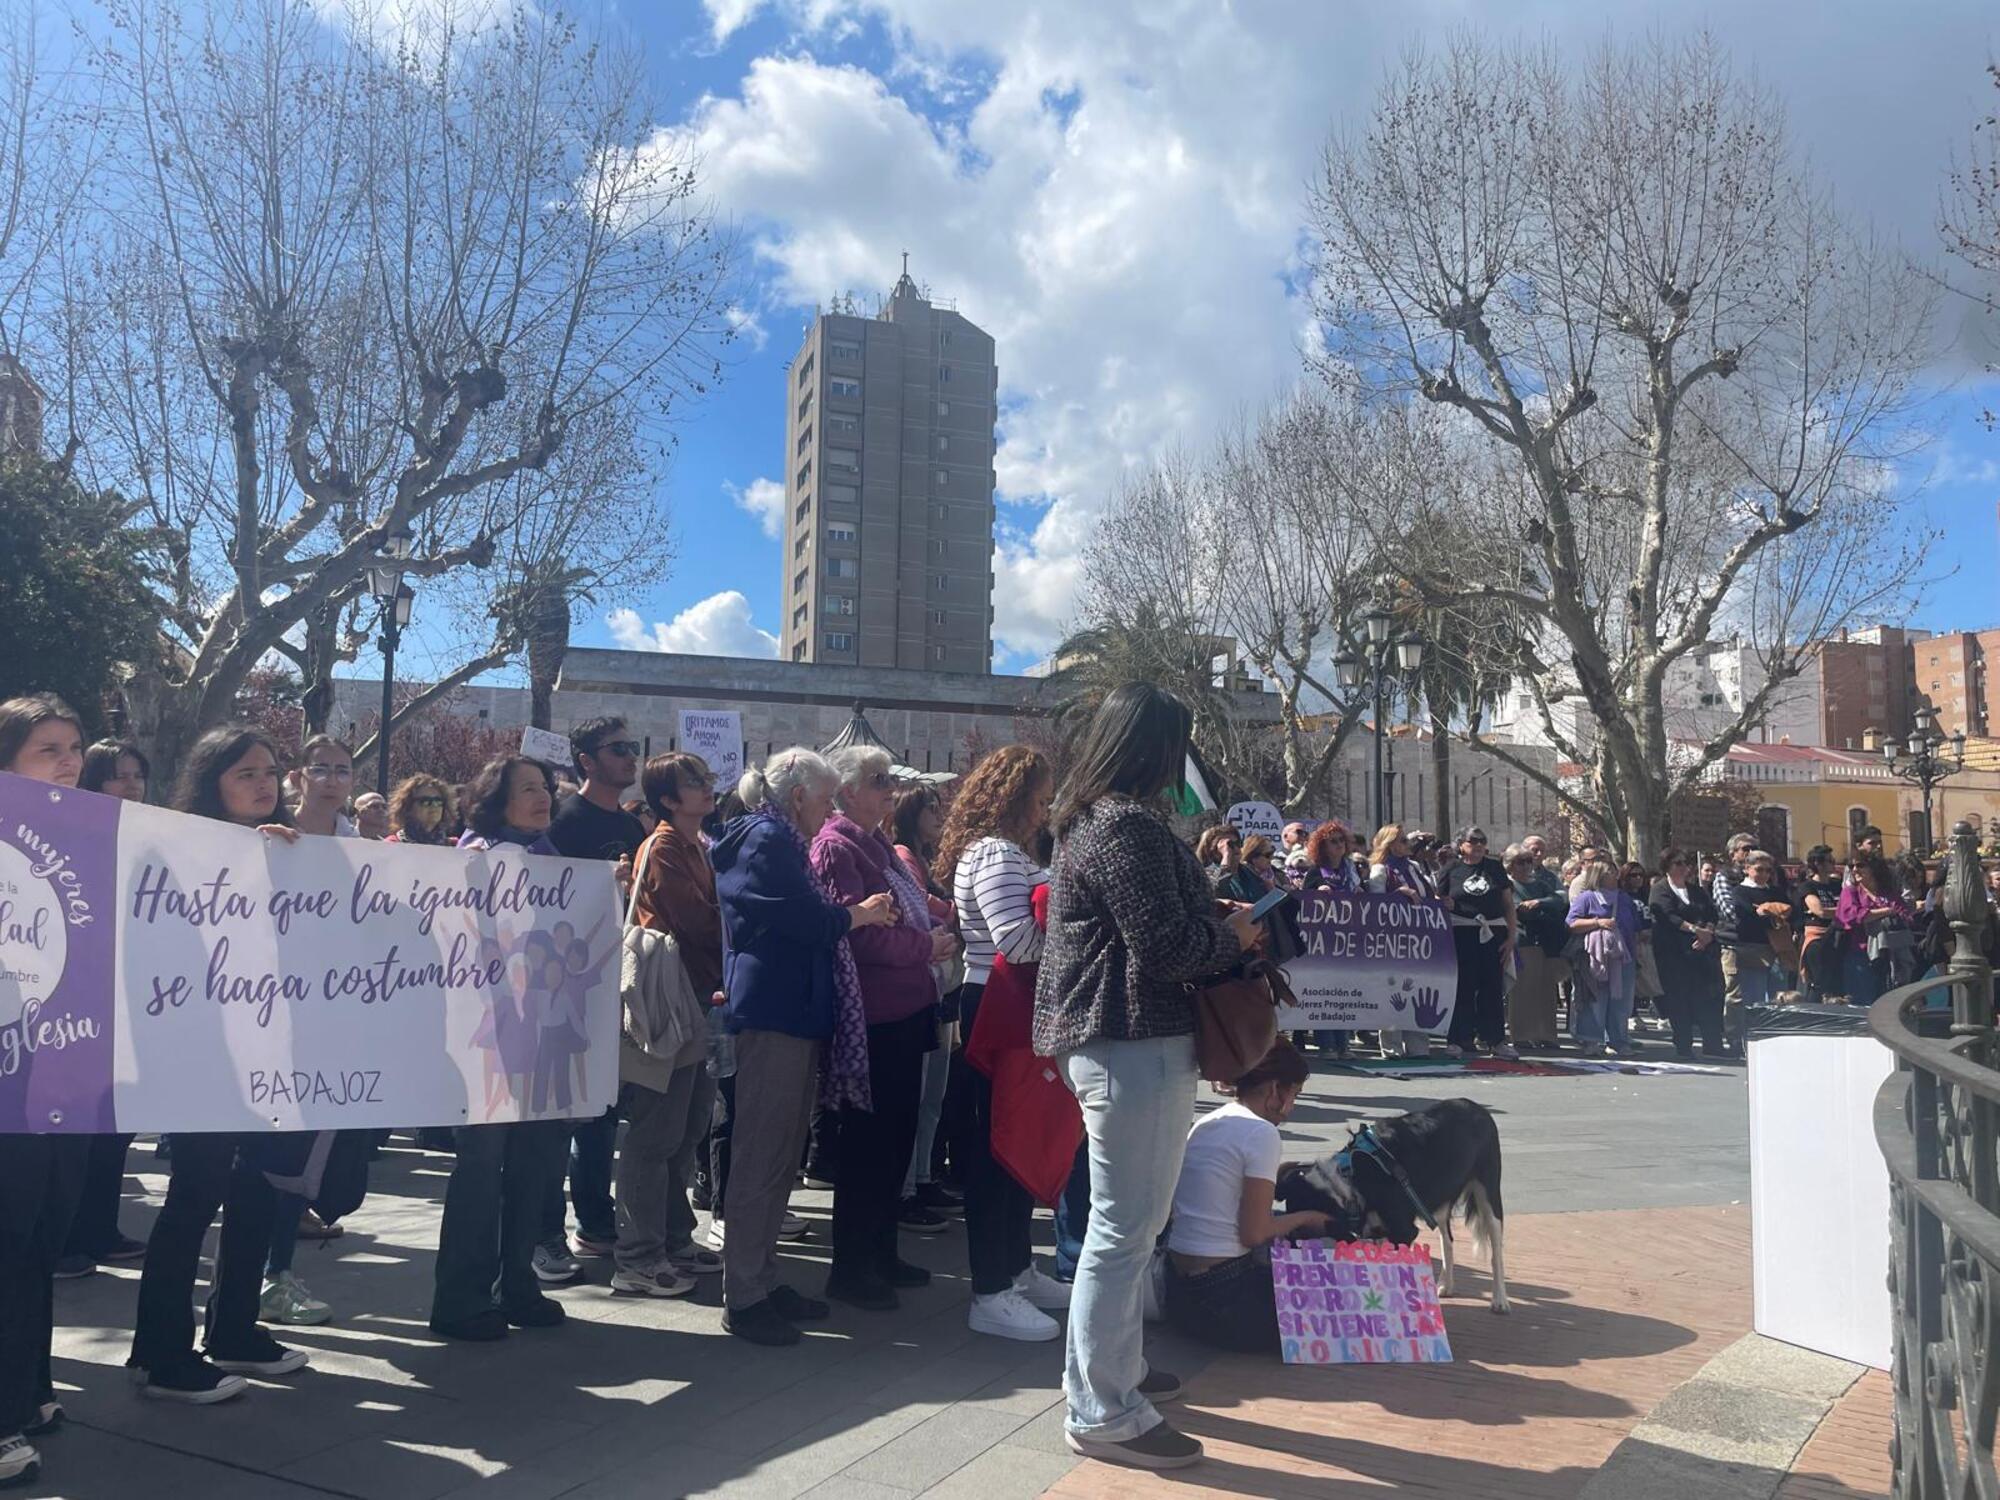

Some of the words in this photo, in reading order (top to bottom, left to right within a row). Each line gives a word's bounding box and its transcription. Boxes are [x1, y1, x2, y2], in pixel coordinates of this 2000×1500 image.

[723, 752, 737, 763] NO
[1245, 821, 1279, 830] PARA
[17, 823, 94, 929] mujeres
[133, 864, 256, 926] Hasta
[268, 886, 337, 935] que
[350, 864, 399, 924] la
[407, 861, 577, 935] igualdad
[1297, 900, 1352, 925] LDAD
[1360, 902, 1371, 926] Y
[1378, 902, 1448, 930] CONTRA
[1333, 931, 1357, 957] DE
[1364, 929, 1433, 960] GÉNERO
[146, 971, 193, 1017] se
[205, 936, 308, 1028] haga
[323, 934, 508, 1005] costumbre
[1302, 987, 1350, 997] Asociación
[1351, 987, 1363, 997] de
[1308, 1012, 1319, 1021] de
[1321, 1012, 1356, 1022] Badajoz
[1324, 1001, 1379, 1010] Progresistas
[0, 998, 101, 1076] glesia
[248, 1070, 384, 1104] BADAJOZ
[1273, 1262, 1370, 1287] PRENDE
[1381, 1265, 1417, 1288] UN
[1275, 1288, 1362, 1312] PORRO
[1279, 1313, 1304, 1336] SI
[1309, 1313, 1390, 1339] VIENE
[1283, 1338, 1452, 1362] POLICIA
